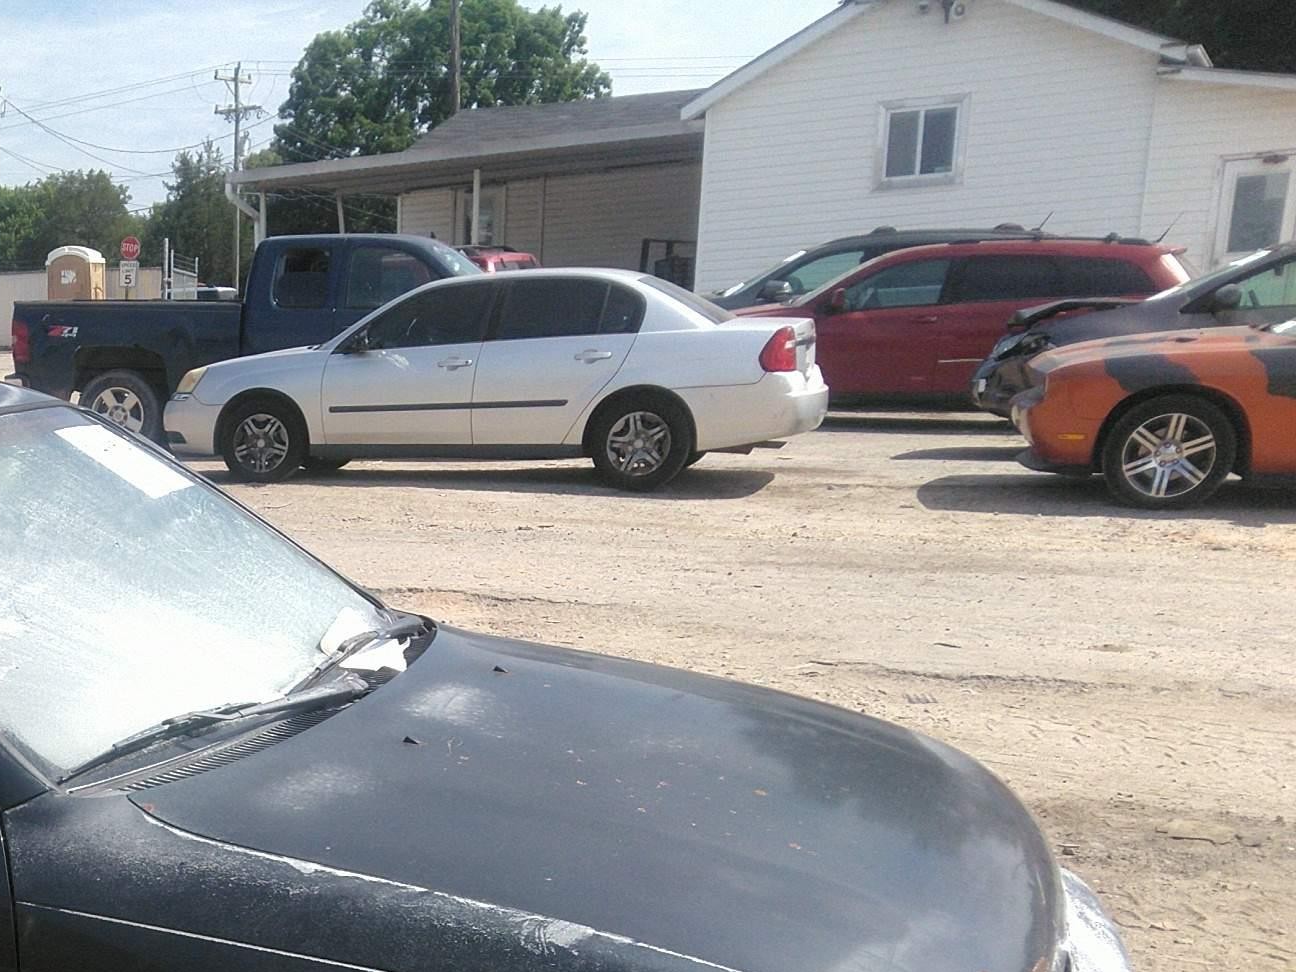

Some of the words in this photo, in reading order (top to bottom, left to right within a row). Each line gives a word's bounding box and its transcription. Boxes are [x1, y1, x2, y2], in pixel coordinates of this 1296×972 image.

[121, 242, 139, 253] STOP
[124, 274, 132, 285] 5
[47, 325, 79, 337] Z71
